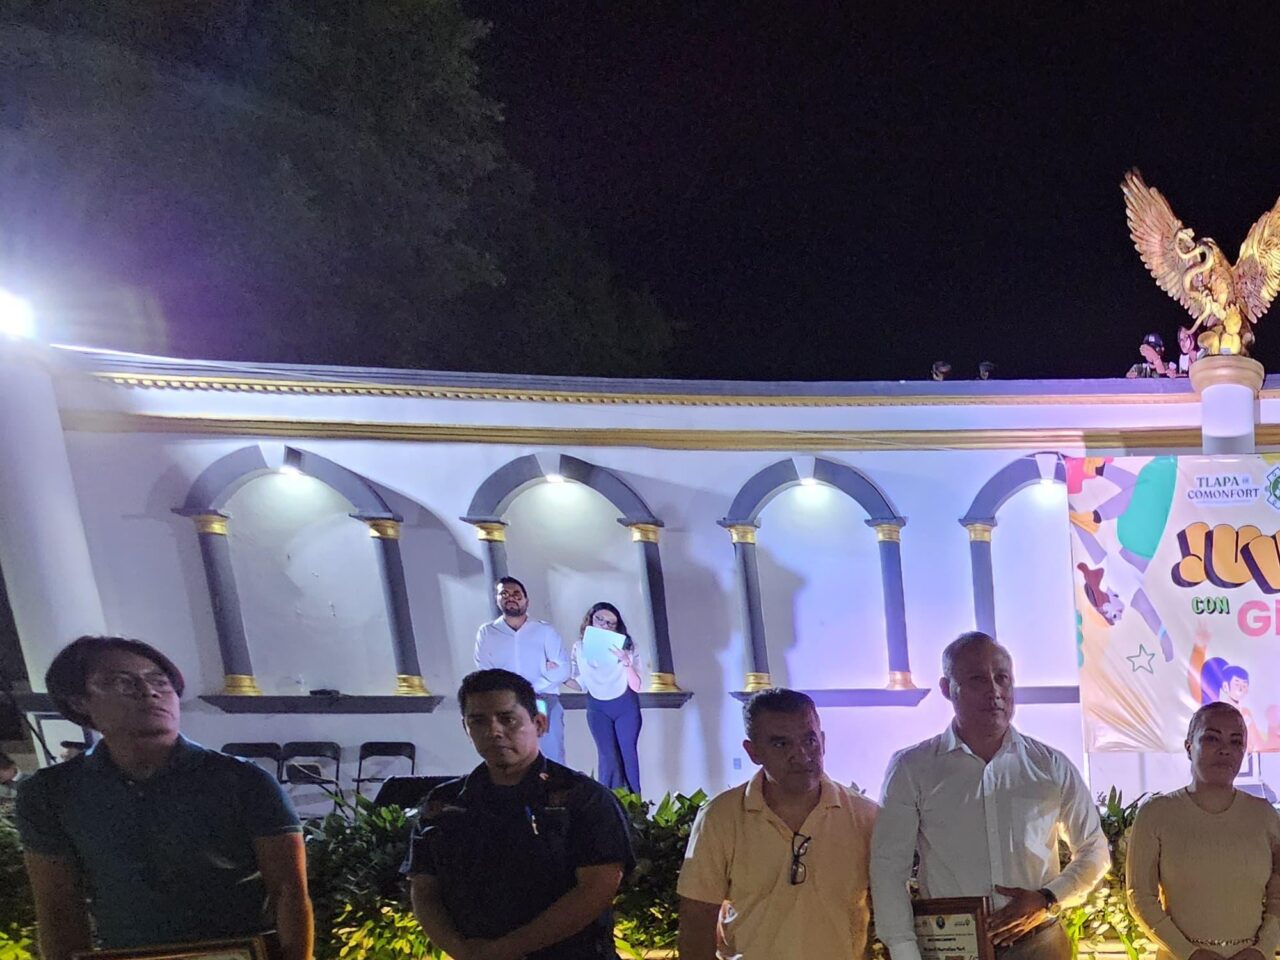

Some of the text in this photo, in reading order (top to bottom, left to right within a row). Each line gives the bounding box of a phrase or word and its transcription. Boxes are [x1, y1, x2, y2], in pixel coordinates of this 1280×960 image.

[1196, 476, 1240, 488] TLAPA
[1187, 488, 1259, 500] COMONFORT
[1191, 596, 1230, 615] CON
